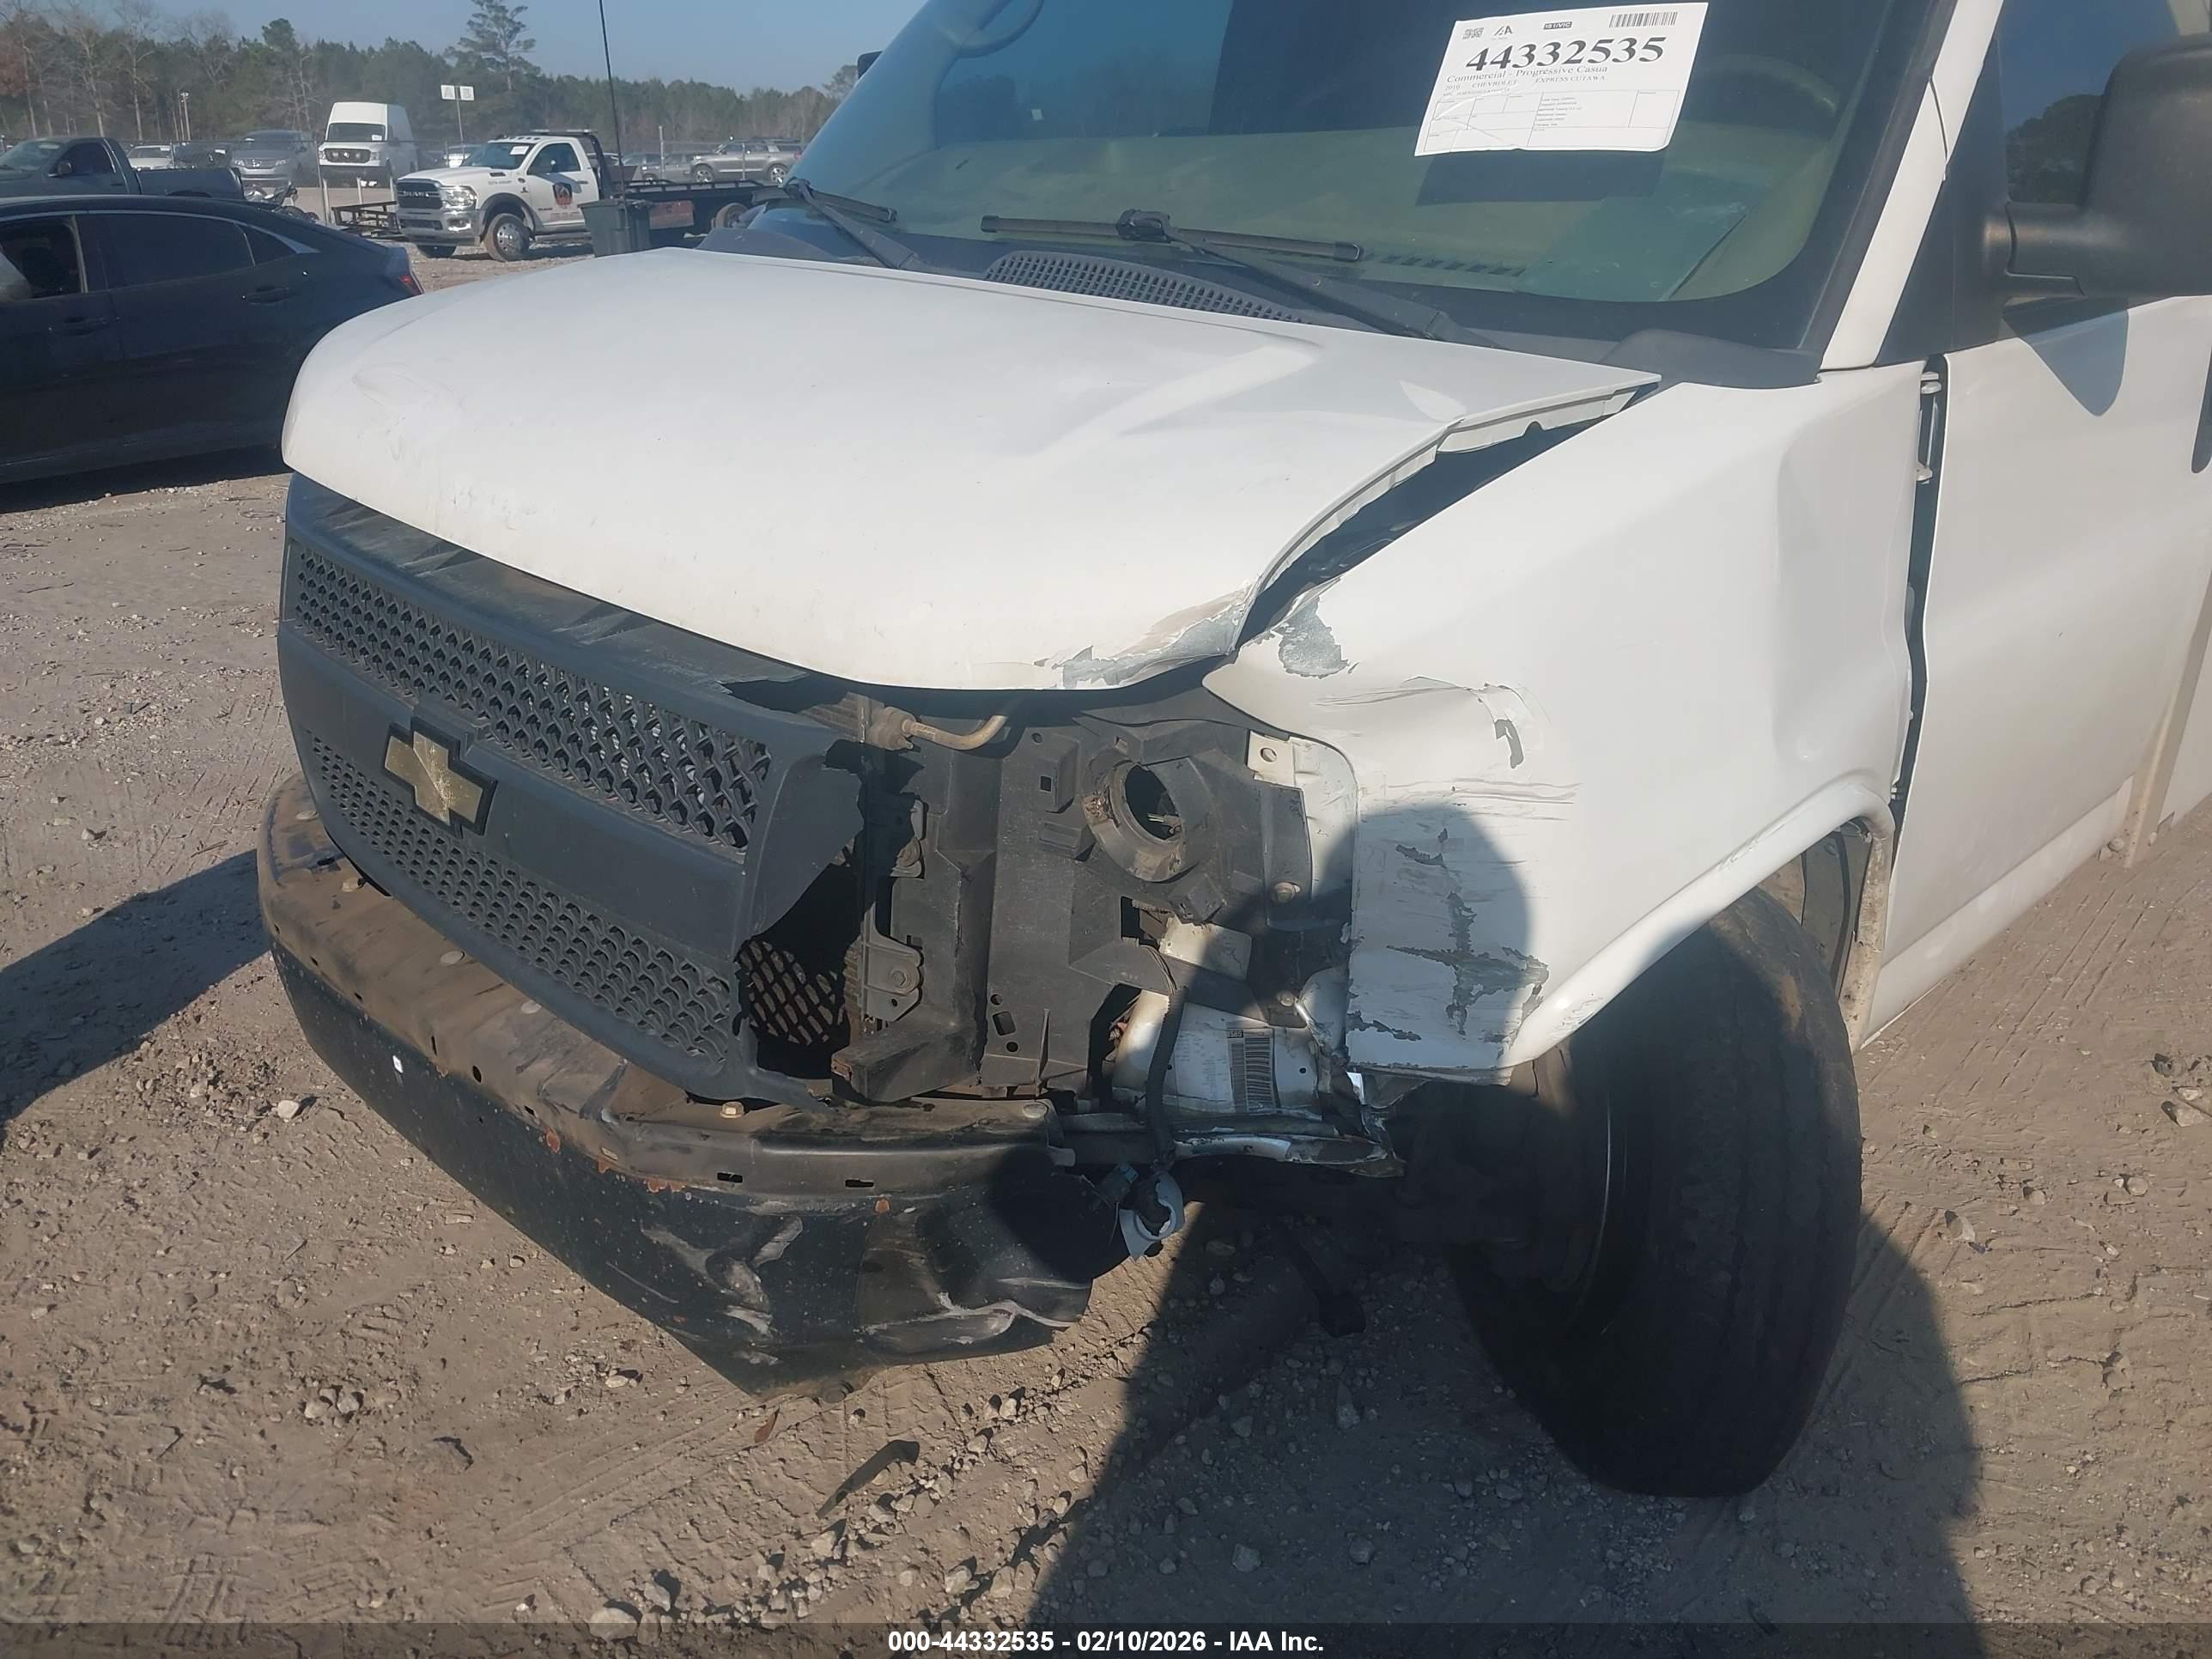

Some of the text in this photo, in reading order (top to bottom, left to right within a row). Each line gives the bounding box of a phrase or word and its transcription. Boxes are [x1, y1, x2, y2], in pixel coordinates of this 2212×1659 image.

[1465, 37, 1667, 71] 44332535
[1447, 70, 1506, 83] Commercial
[1516, 66, 1573, 78] Progressive
[1577, 64, 1608, 74] Casua
[1472, 80, 1518, 88] CHEVROLET
